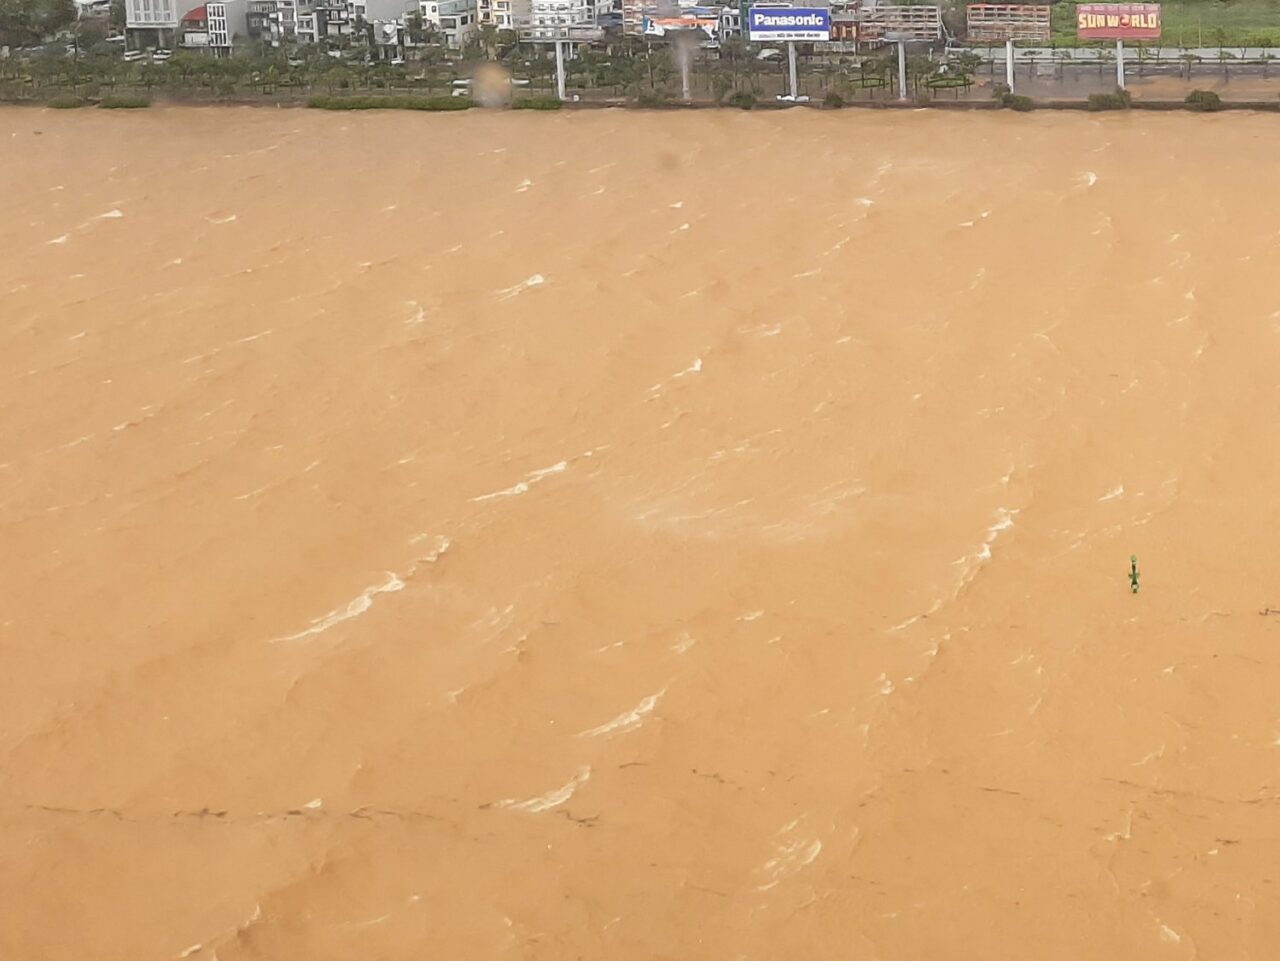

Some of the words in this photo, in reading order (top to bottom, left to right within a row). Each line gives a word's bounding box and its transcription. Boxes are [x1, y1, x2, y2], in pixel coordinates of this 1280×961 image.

[754, 14, 823, 26] Panasonic
[1078, 13, 1105, 28] SUN
[1106, 13, 1157, 28] WORLD
